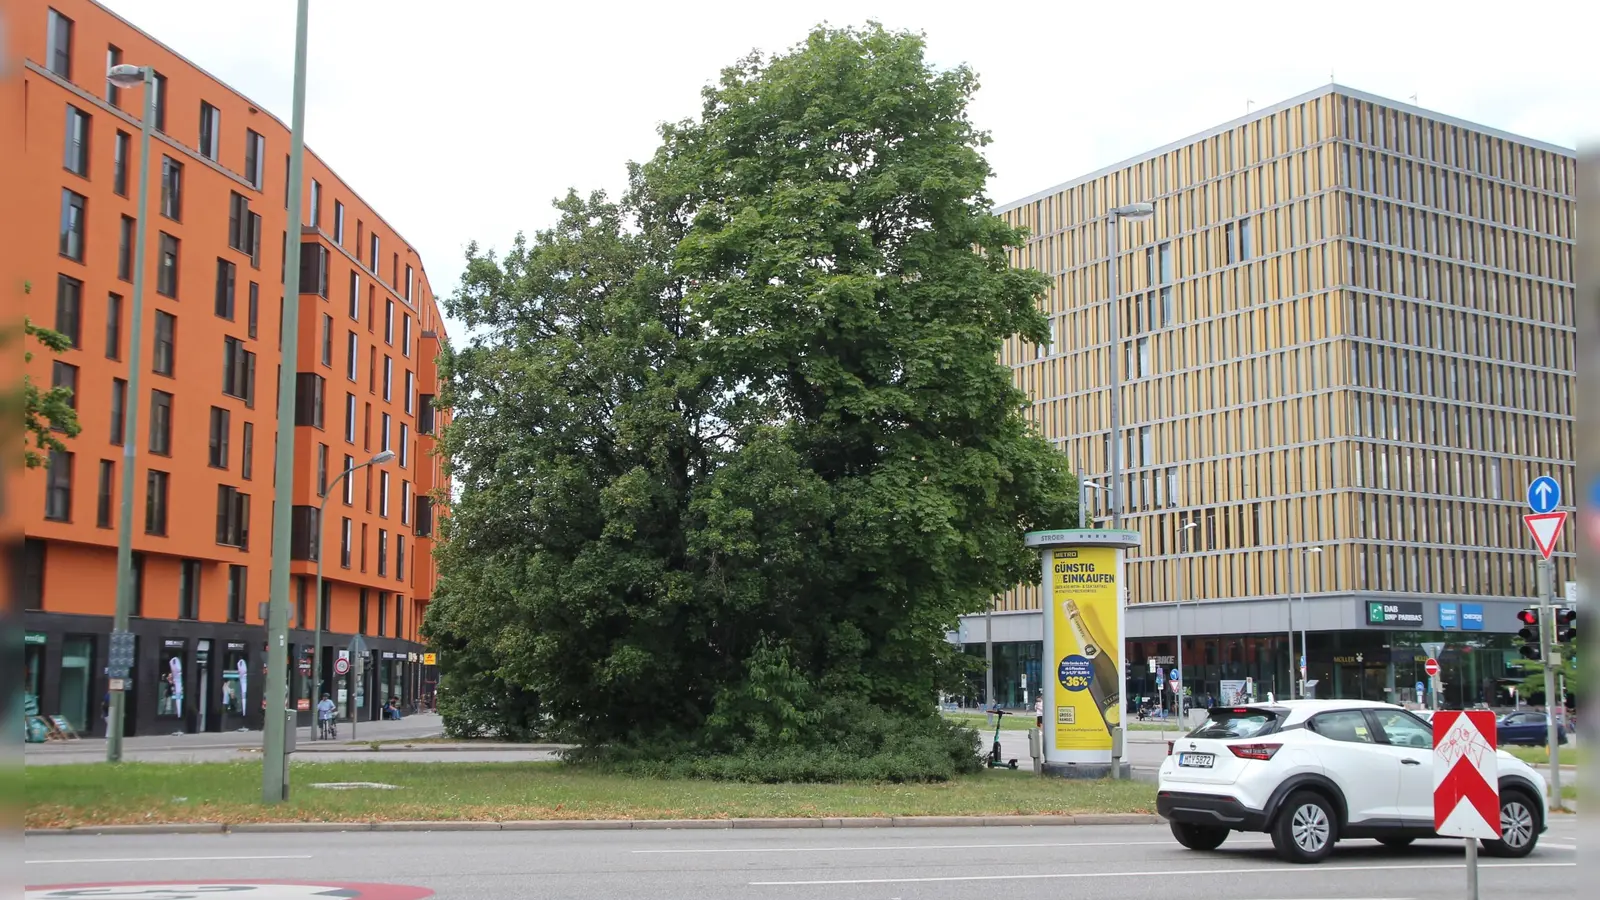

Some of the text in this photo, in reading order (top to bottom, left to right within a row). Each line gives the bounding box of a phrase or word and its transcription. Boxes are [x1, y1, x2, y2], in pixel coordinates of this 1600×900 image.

[1054, 561, 1095, 573] GÜNSTIG
[1062, 573, 1115, 583] EINKAUFEN
[1384, 613, 1397, 621] BNP
[1195, 755, 1211, 764] 5872
